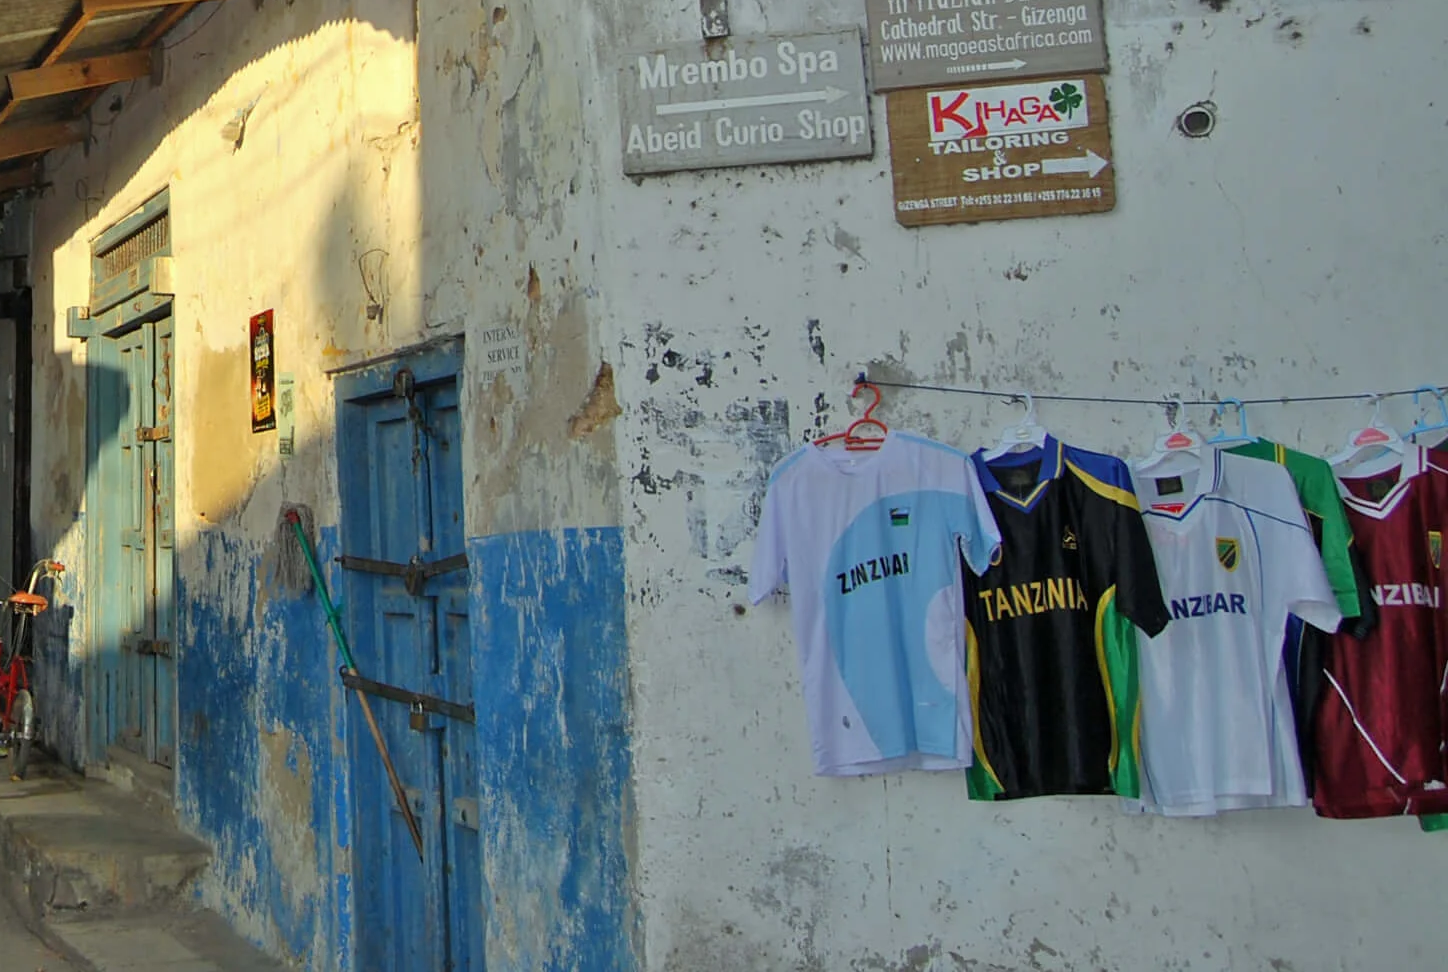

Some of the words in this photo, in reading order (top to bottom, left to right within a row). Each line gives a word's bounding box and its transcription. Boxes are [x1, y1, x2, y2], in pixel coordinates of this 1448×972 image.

[881, 12, 965, 41] Cathedral
[971, 10, 1002, 33] Str.
[1021, 5, 1087, 28] Gizenga
[638, 50, 768, 90] Mrembo
[777, 41, 839, 84] Spa
[627, 122, 702, 154] Abeid
[716, 116, 784, 147] Curio
[798, 109, 865, 145] Shop
[928, 131, 1070, 156] TAILORING
[992, 150, 1008, 167] &
[962, 162, 1042, 182] SHOP
[487, 346, 520, 363] SERVICE
